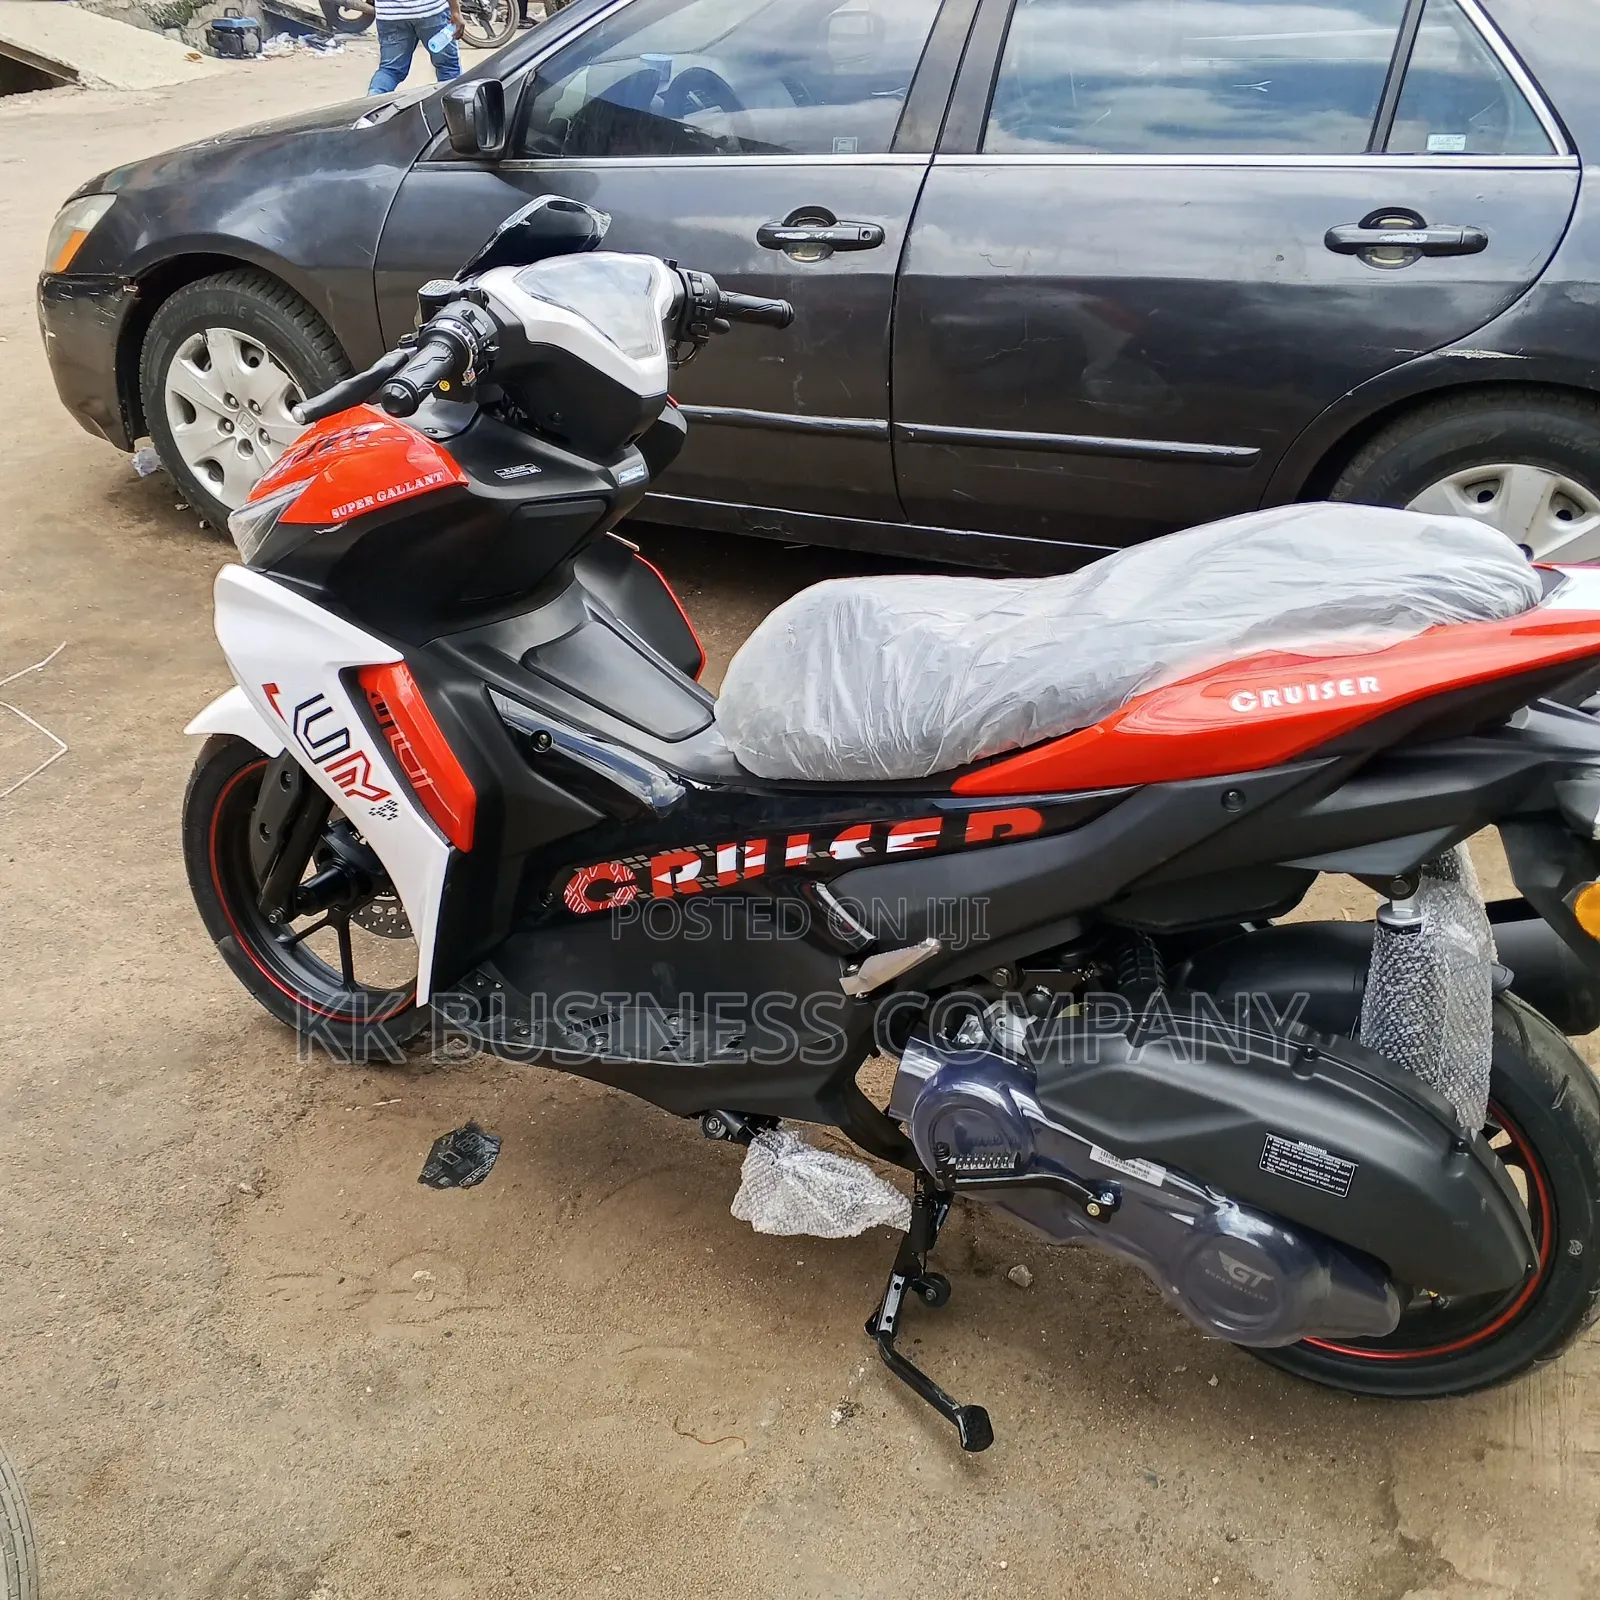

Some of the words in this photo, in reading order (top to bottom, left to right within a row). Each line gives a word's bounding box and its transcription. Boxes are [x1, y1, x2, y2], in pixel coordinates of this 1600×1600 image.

[331, 493, 375, 519] SUPER
[376, 470, 444, 502] GALLANT
[1230, 676, 1380, 712] CRUISER
[1298, 1140, 1328, 1155] WARNING
[1227, 1263, 1274, 1288] GT
